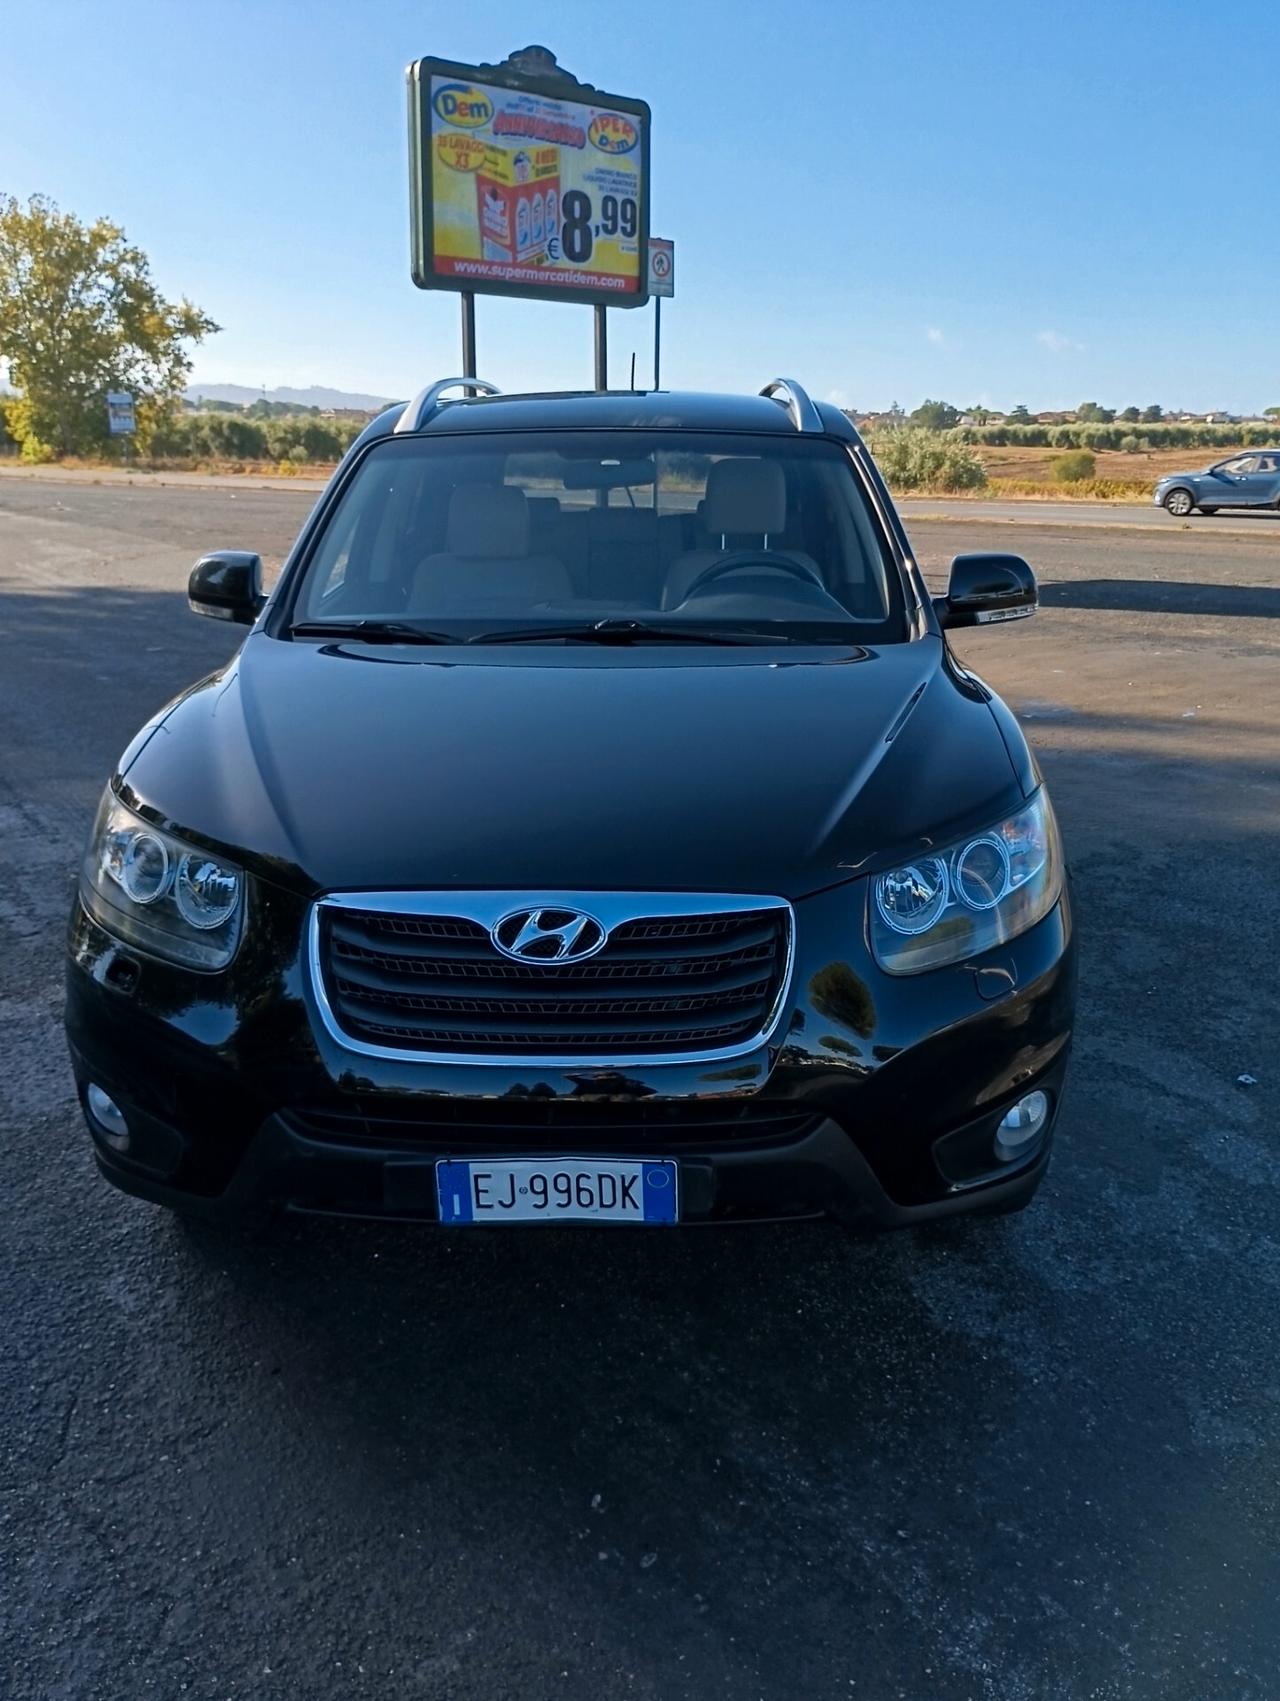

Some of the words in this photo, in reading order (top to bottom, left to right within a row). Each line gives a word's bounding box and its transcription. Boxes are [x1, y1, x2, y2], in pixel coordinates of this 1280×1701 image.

[441, 93, 489, 118] Dem
[592, 116, 634, 137] IPER
[598, 134, 629, 150] Dem
[561, 189, 638, 263] 8,99
[454, 260, 626, 289] www.supermercatidem.com
